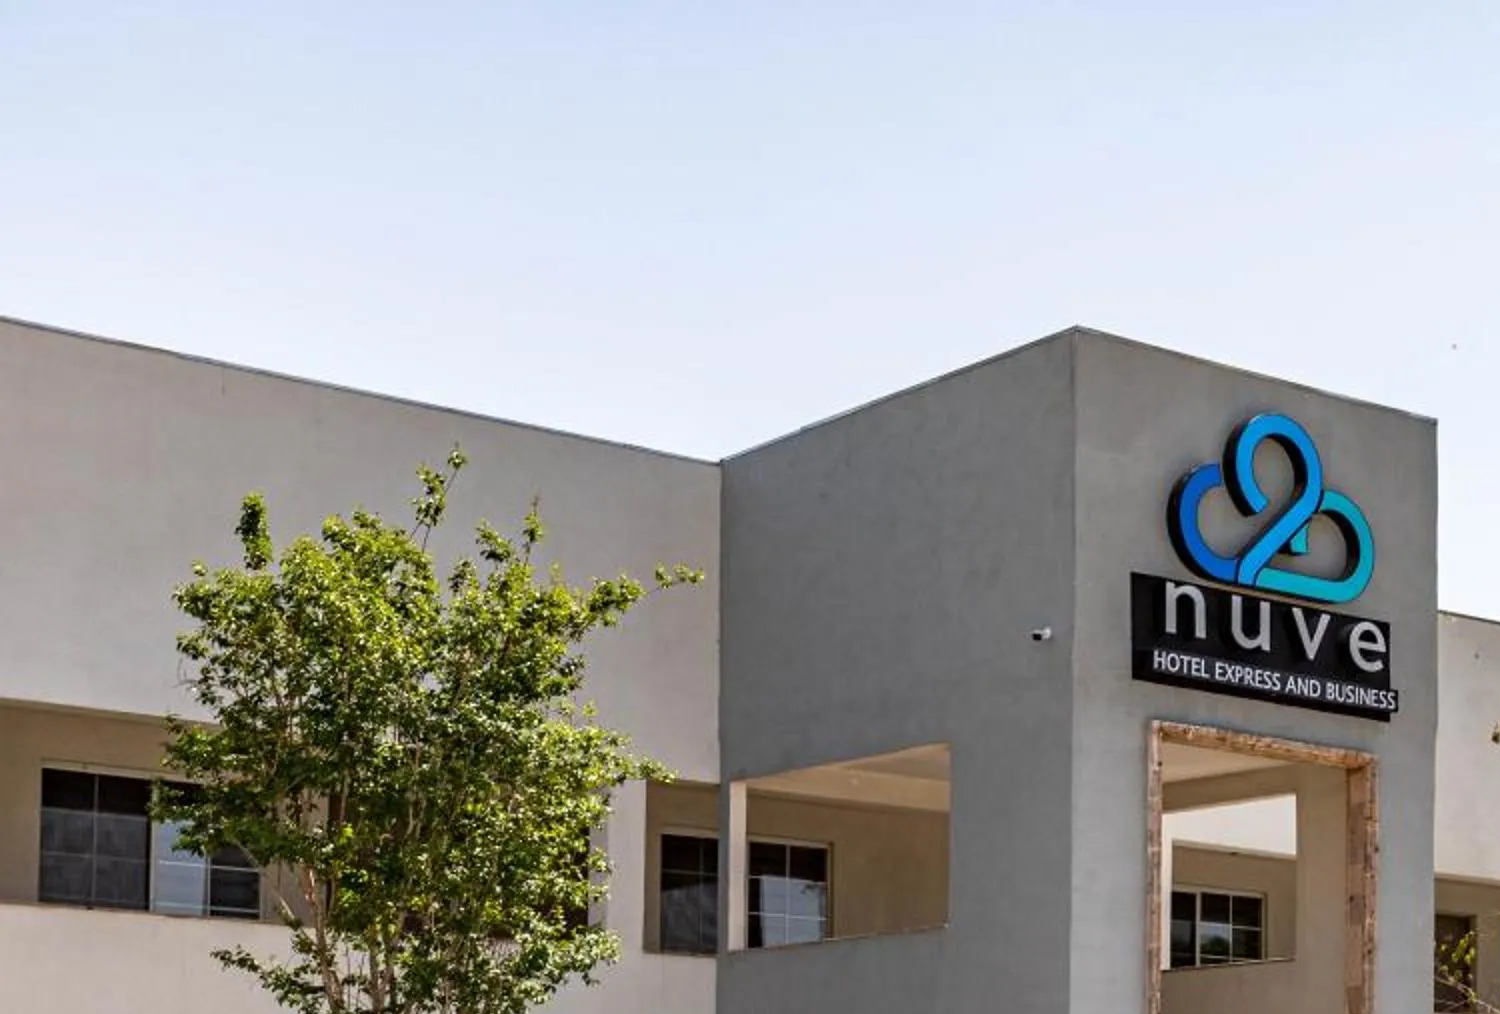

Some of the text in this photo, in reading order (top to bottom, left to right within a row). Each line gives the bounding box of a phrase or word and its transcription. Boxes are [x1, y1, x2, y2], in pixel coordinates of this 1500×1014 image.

[1164, 580, 1387, 673] nuve
[1152, 648, 1396, 709] HOTEL EXPRESS AND BUSINESS
